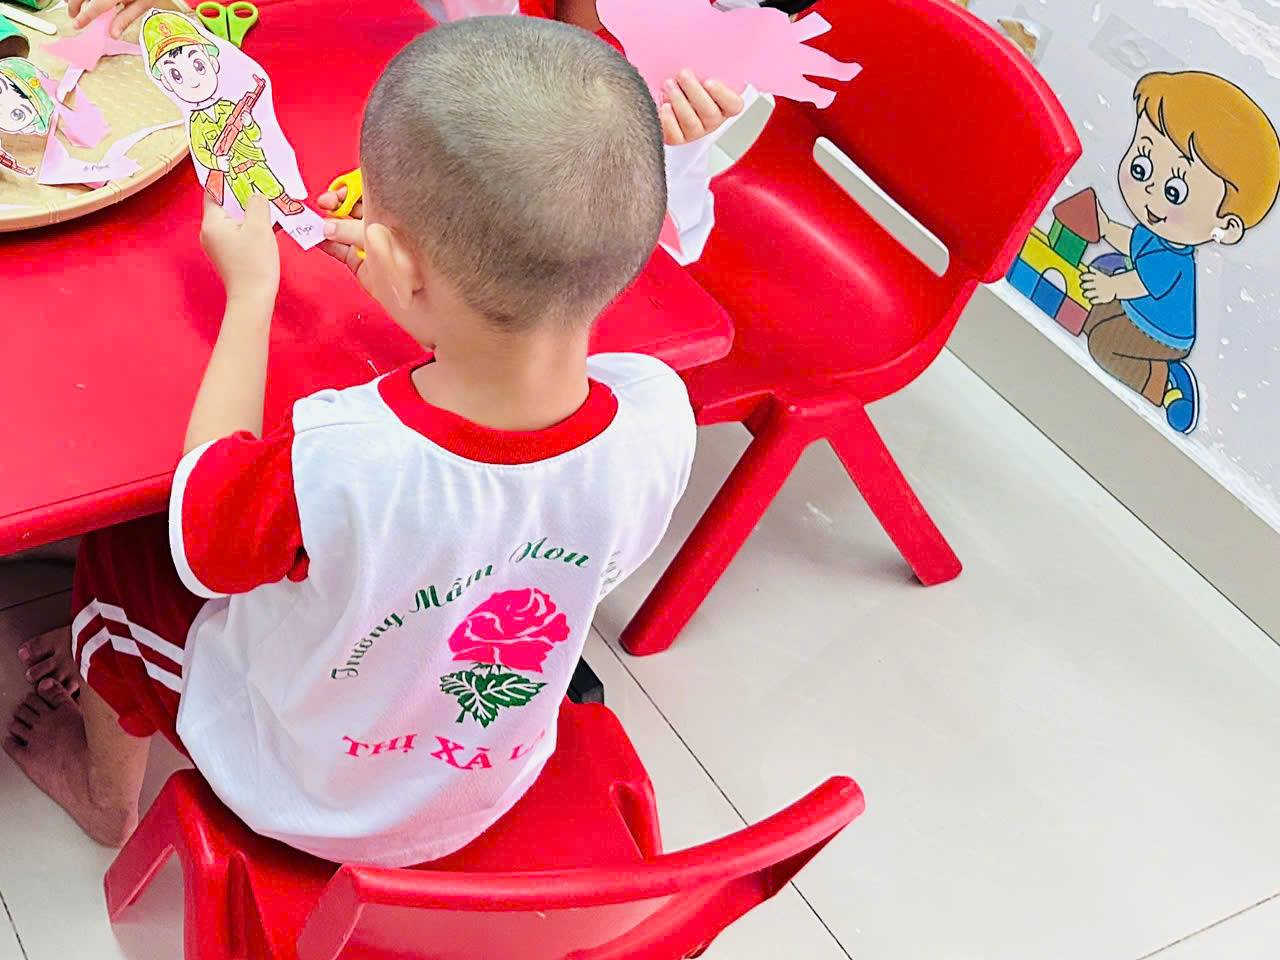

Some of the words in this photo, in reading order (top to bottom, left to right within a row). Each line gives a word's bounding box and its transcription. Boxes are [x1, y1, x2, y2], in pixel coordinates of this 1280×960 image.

[330, 612, 406, 681] Trường
[508, 536, 590, 568] Non
[341, 733, 419, 758] THỊ
[429, 735, 494, 771] XÃ
